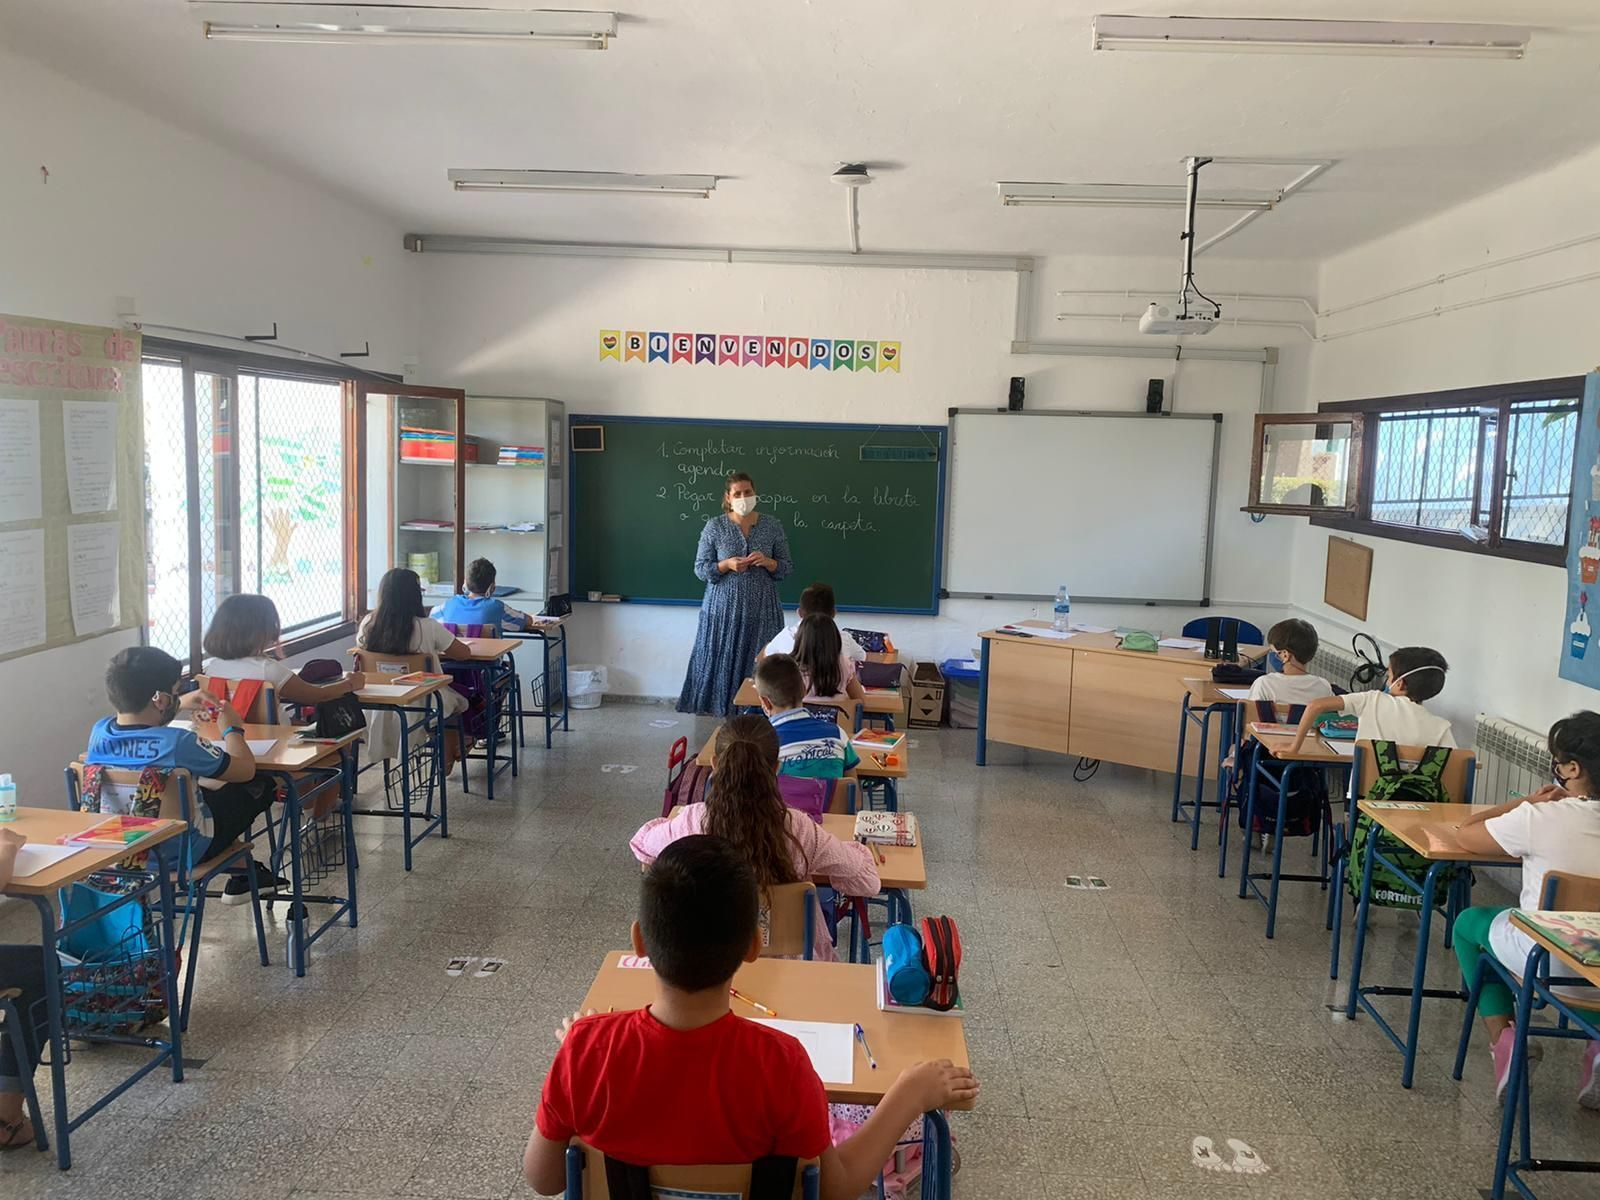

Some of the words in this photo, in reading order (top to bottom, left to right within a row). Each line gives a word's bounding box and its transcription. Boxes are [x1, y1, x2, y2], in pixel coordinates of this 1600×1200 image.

[103, 329, 135, 361] de
[630, 338, 871, 360] BIENVENIDOS
[673, 438, 745, 462] Completar
[677, 461, 736, 485] agenda
[673, 482, 717, 511] Pegar
[1375, 889, 1424, 905] FORTNITE
